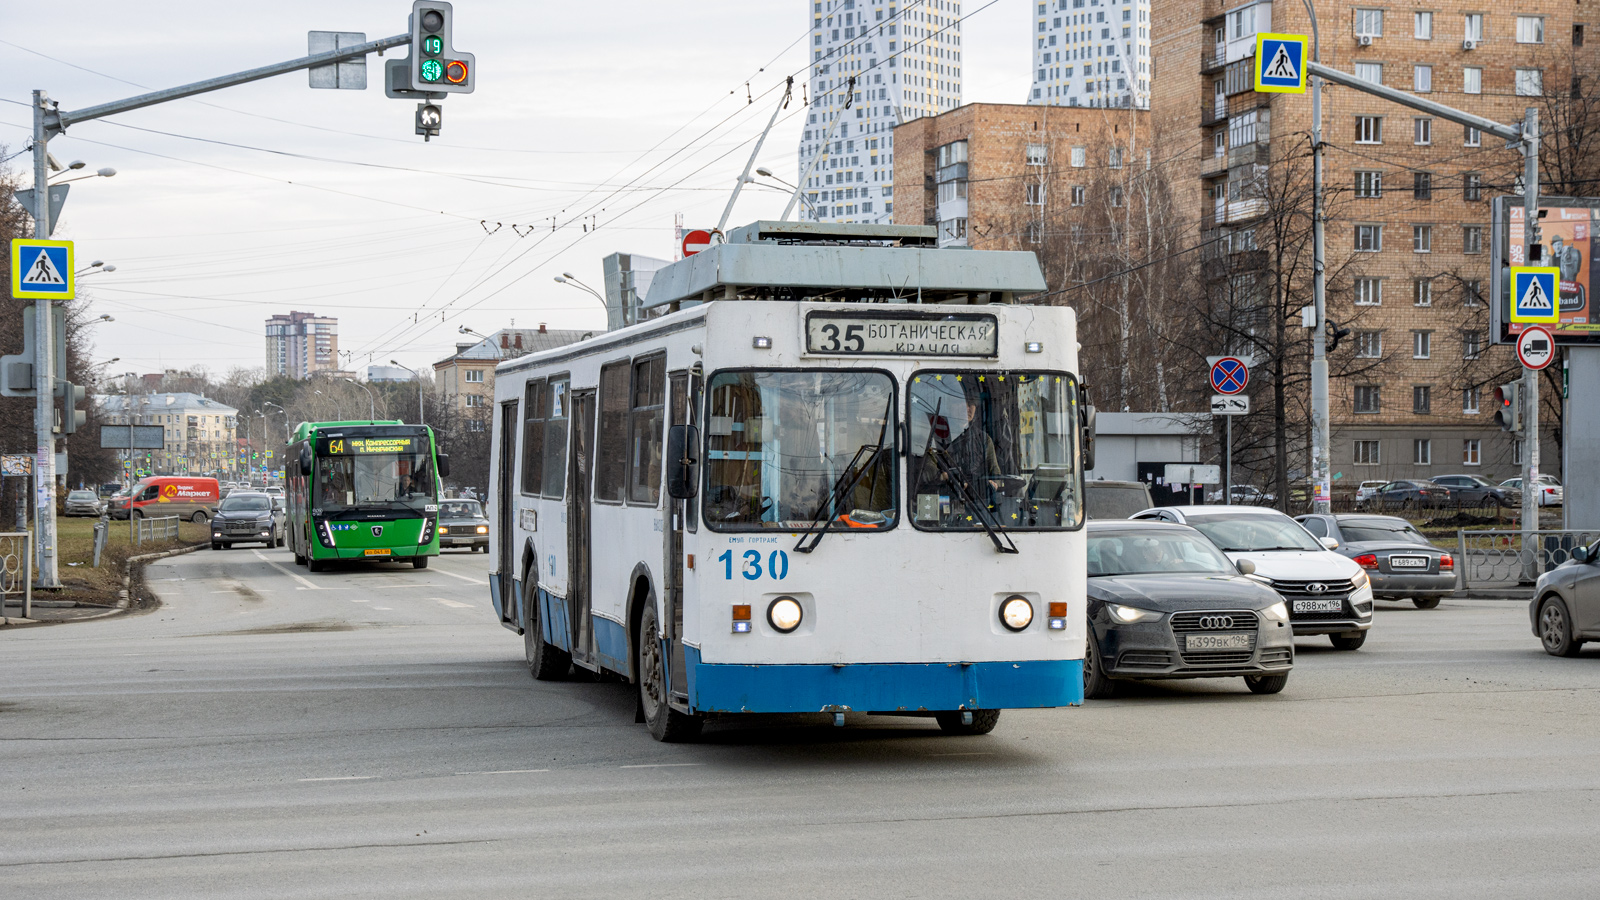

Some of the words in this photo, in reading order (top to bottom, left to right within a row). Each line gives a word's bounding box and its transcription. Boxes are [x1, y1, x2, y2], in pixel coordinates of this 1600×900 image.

[426, 39, 440, 53] 19
[820, 323, 865, 352] 35
[868, 323, 987, 341] БОТАНИЧЕСКАЯ
[329, 440, 344, 454] 64
[748, 536, 778, 544] ГОРТРАНС
[718, 549, 789, 581] 130
[1295, 601, 1327, 610] С988ХМ
[1328, 600, 1340, 608] 196
[1189, 636, 1229, 648] Н399ВК
[1231, 635, 1246, 645] 196
